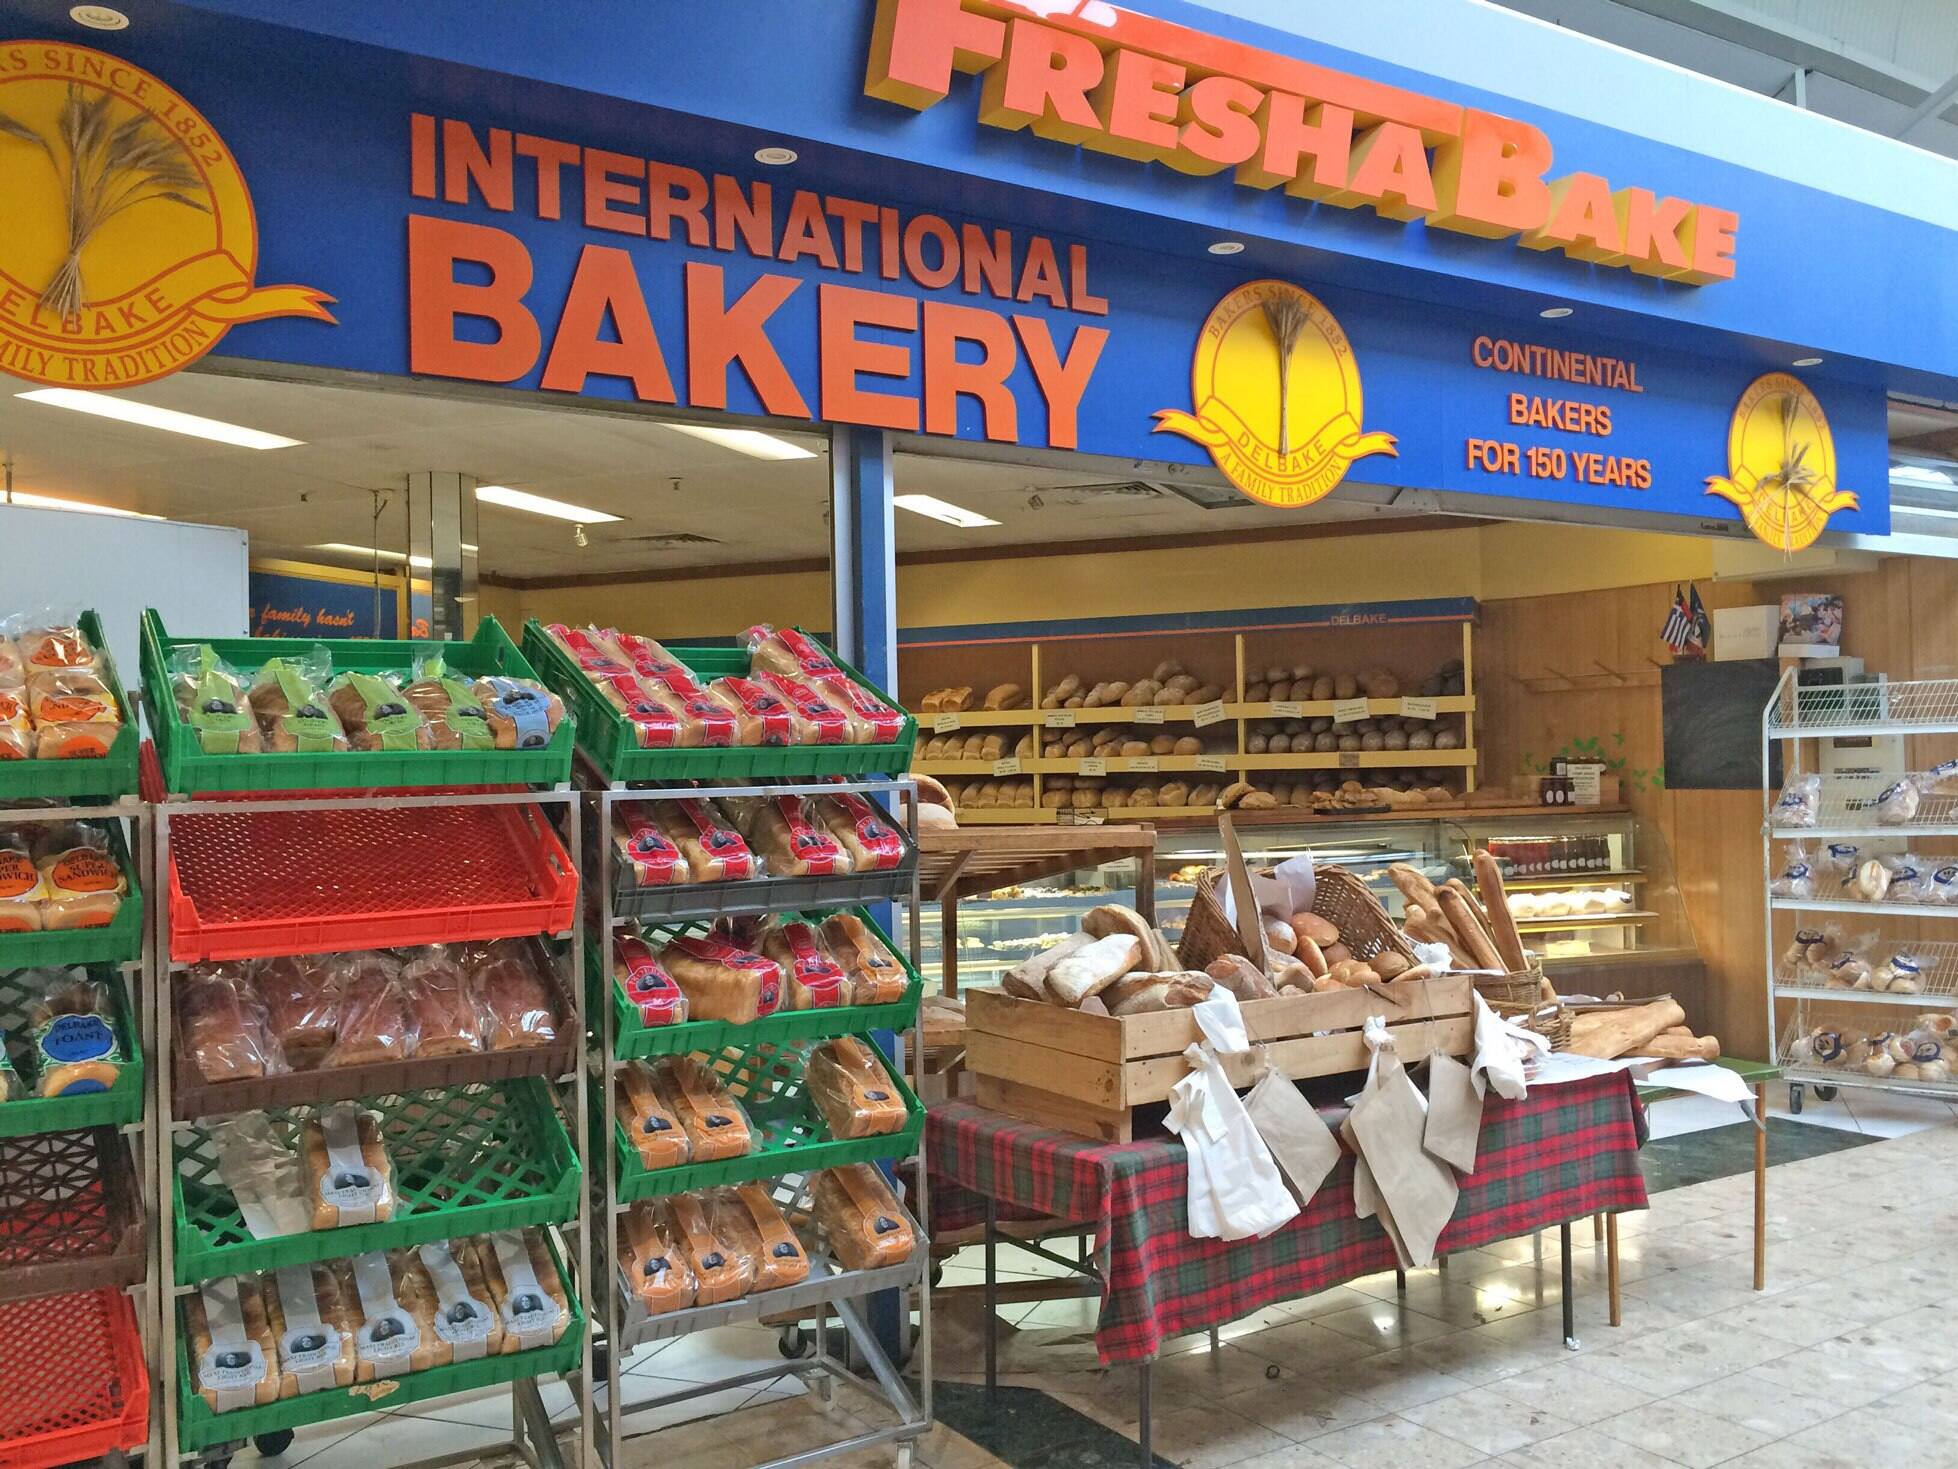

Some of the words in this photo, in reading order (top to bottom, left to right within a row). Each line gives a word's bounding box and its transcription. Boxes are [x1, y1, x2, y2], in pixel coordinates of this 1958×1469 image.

[44, 49, 152, 99] SINCE
[156, 103, 223, 168] 1852
[410, 112, 1109, 316] INTERNATIONAL
[63, 322, 210, 384] TRADITION
[408, 213, 1111, 450] BAKERY
[1473, 335, 1644, 393] CONTINENTAL
[1509, 392, 1613, 436] BAKERS
[1237, 431, 1328, 473] DELBAKE
[1467, 438, 1520, 474] FOR
[1527, 446, 1567, 480] 150
[1572, 451, 1652, 489] YEARS
[1230, 465, 1275, 500] FAMILY
[1279, 461, 1343, 503] TRADITION
[261, 603, 311, 628] family
[1331, 613, 1388, 626] DELBAKE
